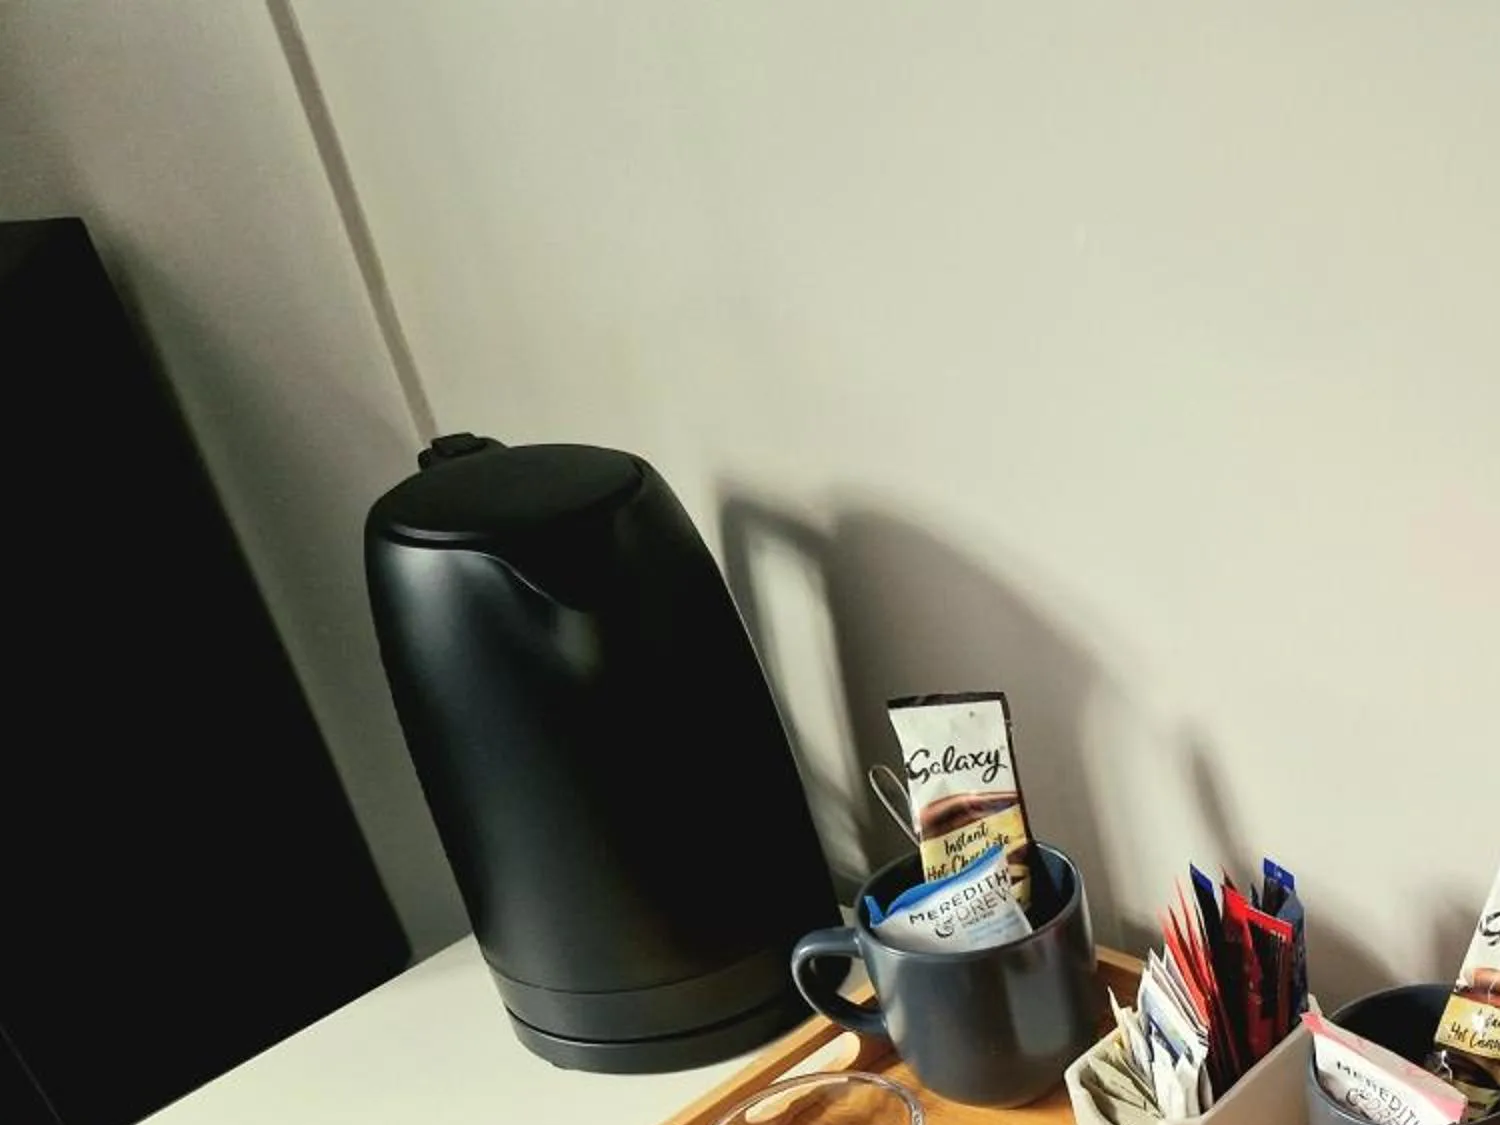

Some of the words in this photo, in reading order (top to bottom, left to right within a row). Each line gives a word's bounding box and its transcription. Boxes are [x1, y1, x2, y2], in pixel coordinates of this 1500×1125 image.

[906, 745, 1007, 784] Galaxy
[944, 822, 988, 855] Instant
[909, 868, 1009, 925] MEREDITH
